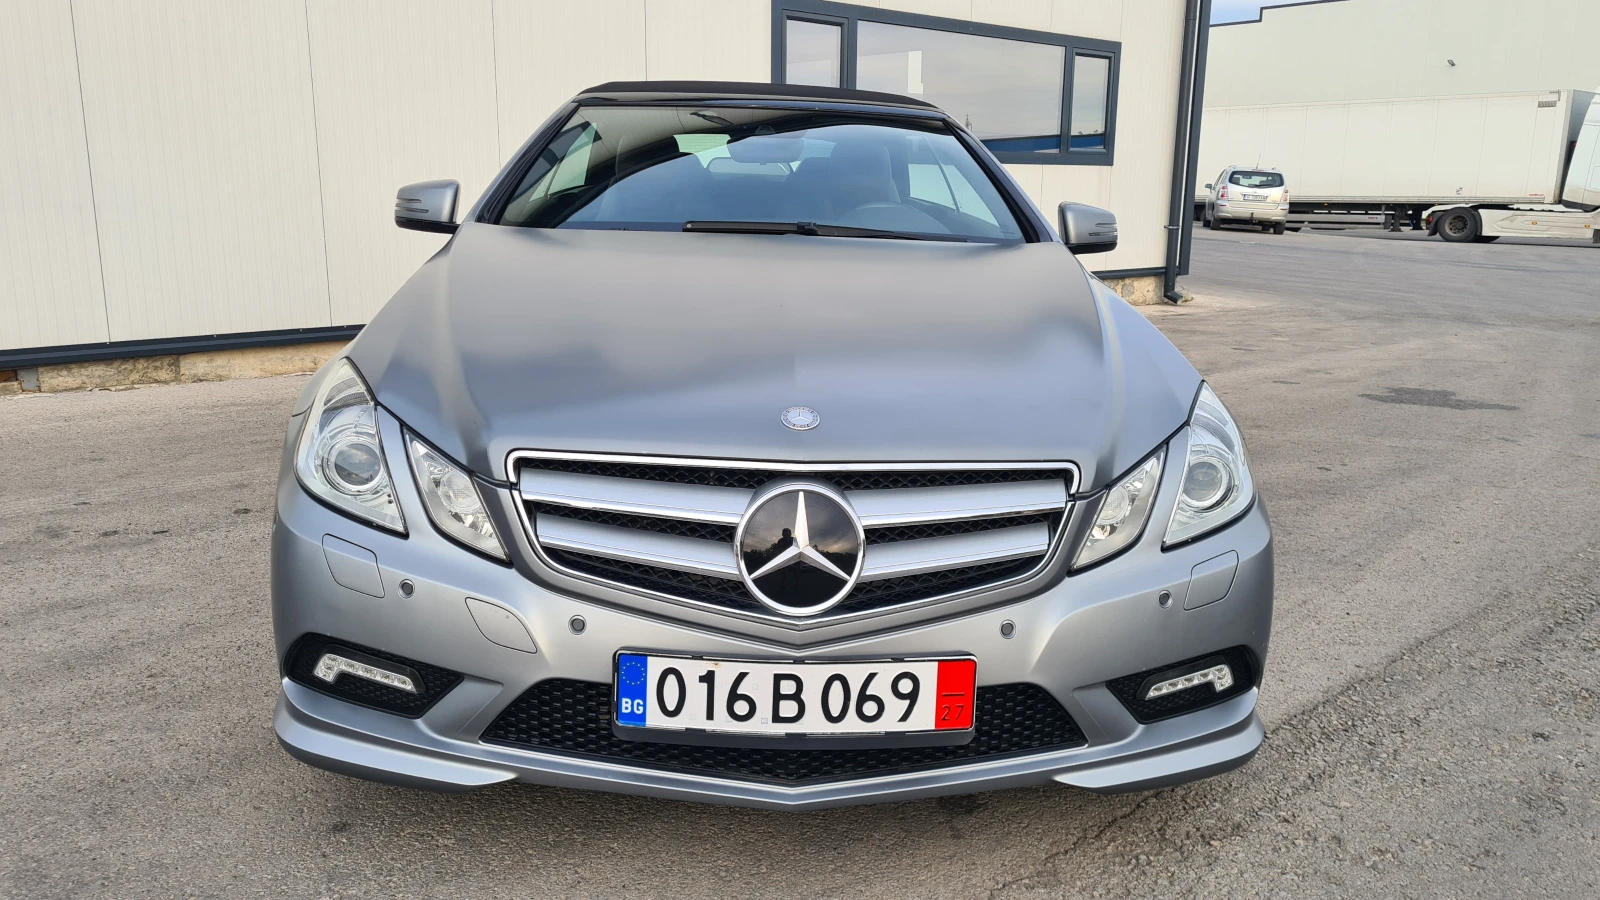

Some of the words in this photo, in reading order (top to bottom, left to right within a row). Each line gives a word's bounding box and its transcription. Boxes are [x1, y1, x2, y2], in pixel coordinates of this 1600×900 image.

[656, 667, 757, 723] 016
[771, 673, 806, 724] B
[820, 671, 921, 724] 069
[621, 697, 644, 715] BG
[941, 703, 965, 721] 27
